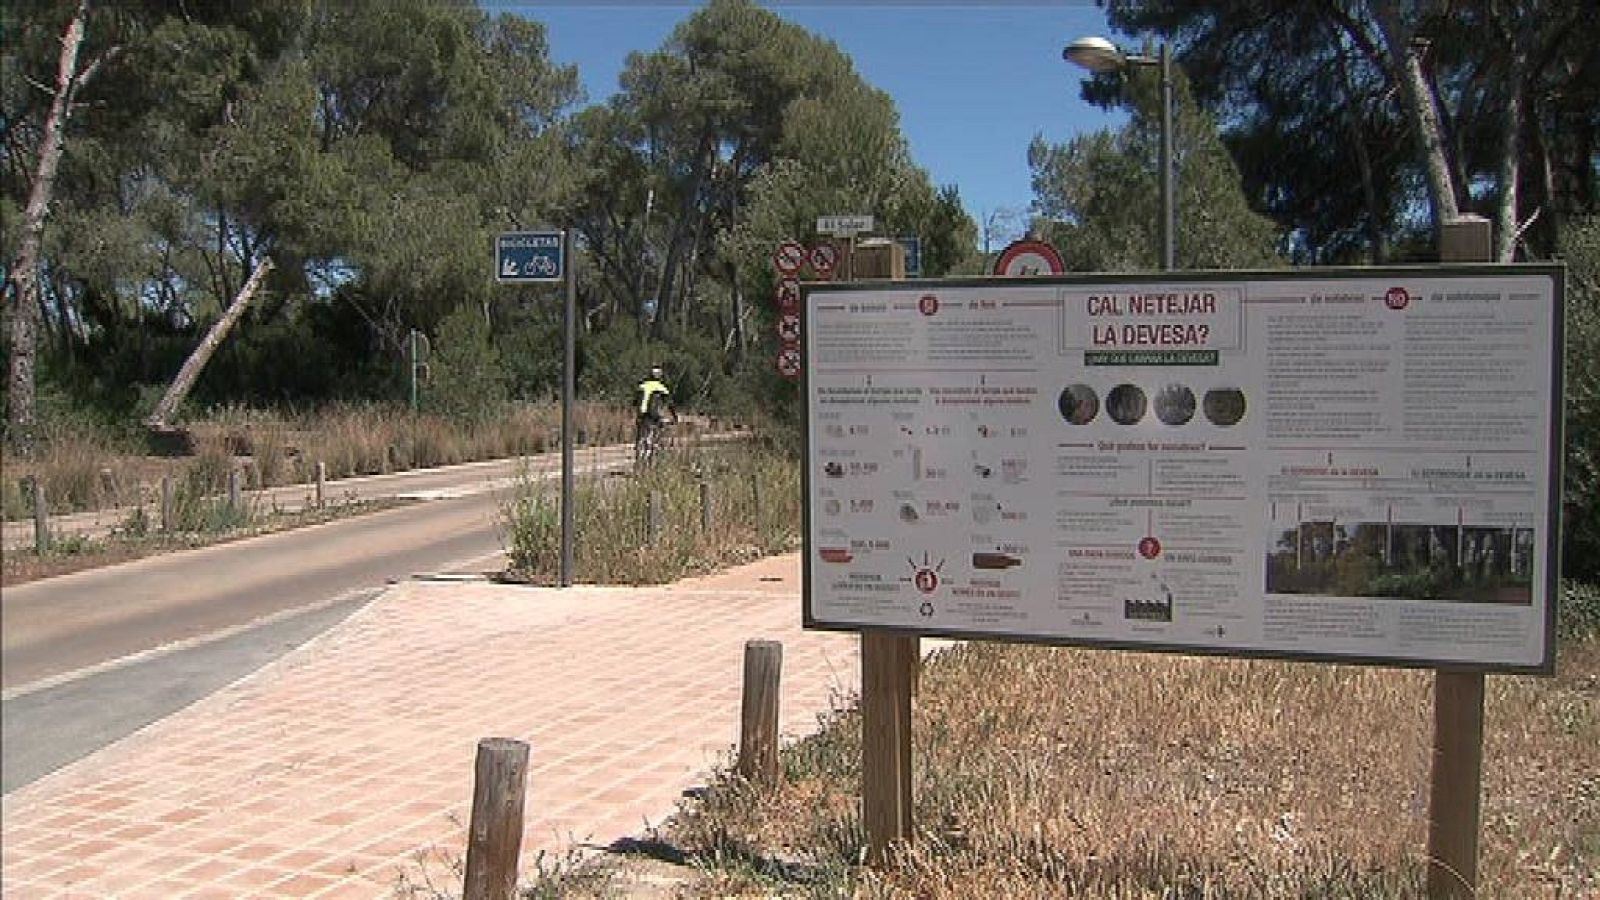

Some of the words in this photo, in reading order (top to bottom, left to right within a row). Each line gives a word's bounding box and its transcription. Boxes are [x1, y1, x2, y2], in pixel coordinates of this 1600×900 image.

[500, 237, 559, 249] BICICLETAS
[1088, 296, 1123, 316] CAL
[1128, 293, 1216, 314] NETEJAR
[1093, 325, 1117, 345] LA
[1123, 324, 1210, 345] DEVESA?
